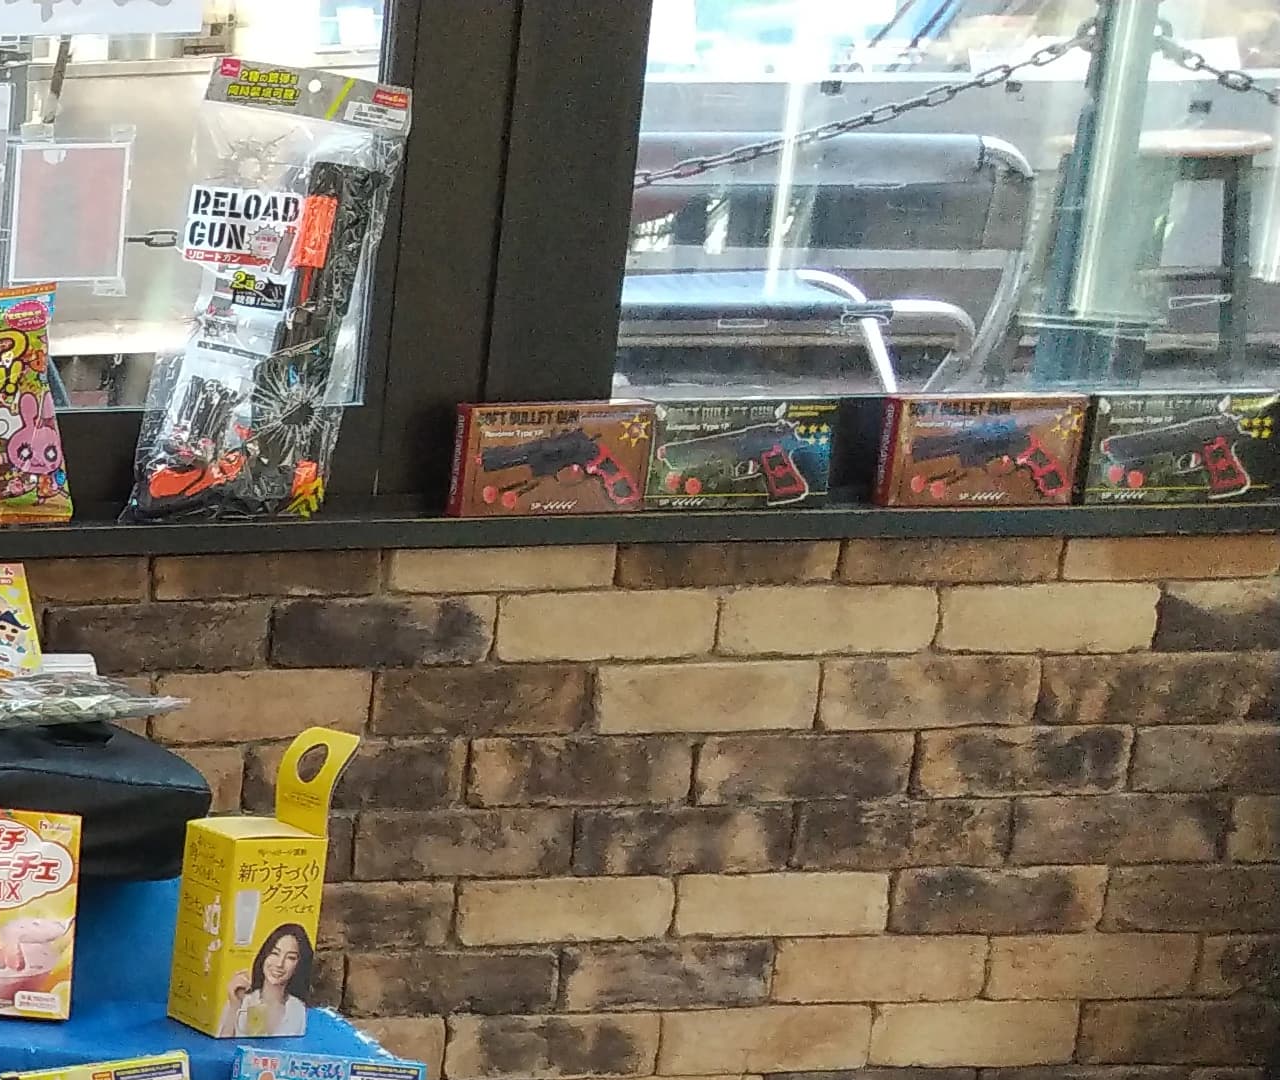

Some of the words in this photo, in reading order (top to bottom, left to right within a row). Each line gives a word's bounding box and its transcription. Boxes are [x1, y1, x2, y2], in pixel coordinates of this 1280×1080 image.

[192, 189, 300, 223] RELOAD
[189, 220, 246, 251] GUN
[238, 859, 320, 882] 新うすづくり
[262, 883, 309, 904] グラス
